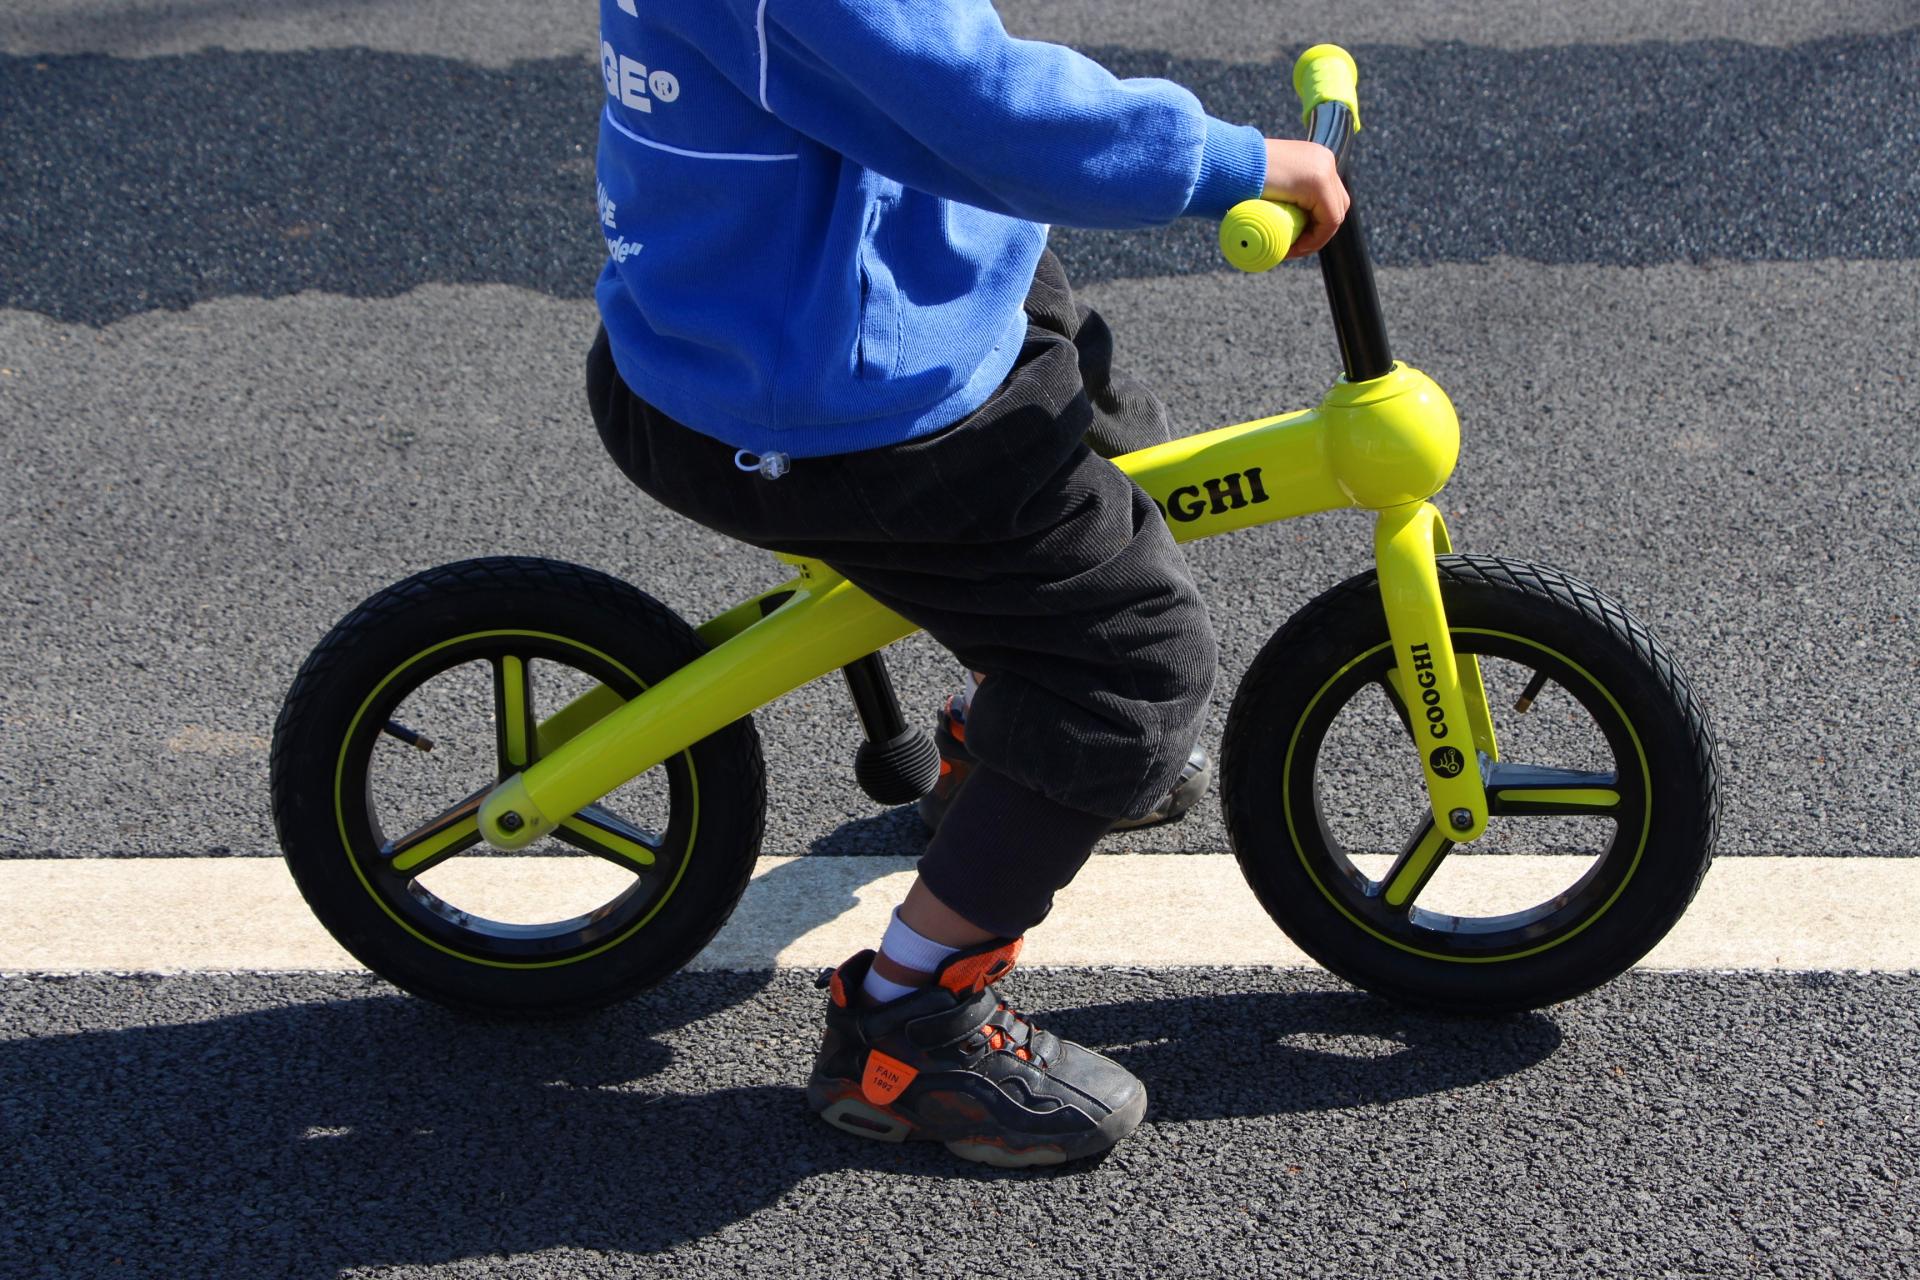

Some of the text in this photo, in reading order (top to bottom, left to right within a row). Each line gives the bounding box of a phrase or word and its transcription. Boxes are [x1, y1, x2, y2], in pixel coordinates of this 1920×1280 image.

[1152, 467, 1270, 522] GHI
[1411, 642, 1448, 739] COOGHI
[876, 1065, 900, 1083] FAIN
